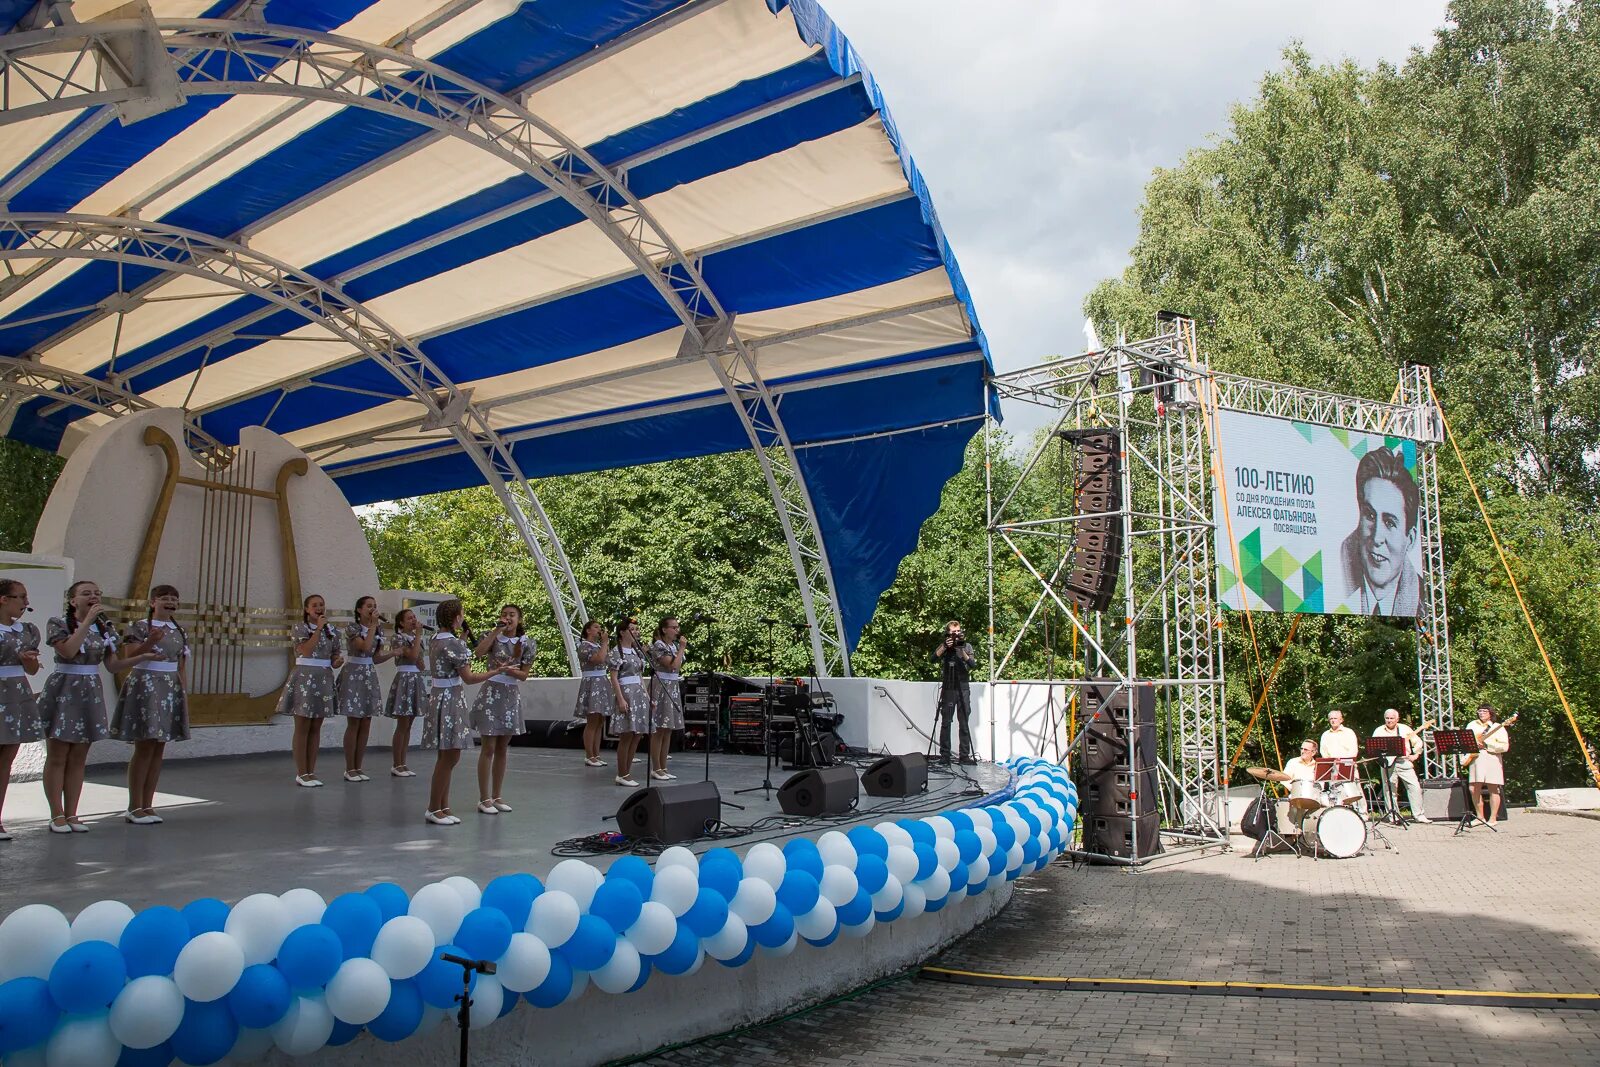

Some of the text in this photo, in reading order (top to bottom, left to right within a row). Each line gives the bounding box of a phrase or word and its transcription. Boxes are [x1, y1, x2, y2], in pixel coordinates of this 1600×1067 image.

[1234, 466, 1314, 496] 100-ЛЕТИЮ
[1235, 492, 1315, 509] СО ДНЯ РОЖДЕНИЯ ПОЭТА
[1236, 505, 1317, 524] АЛЕКСЕЯ ФАТЬЯНОВА
[1273, 522, 1317, 536] ПОСВЯЩАЕТСЯ
